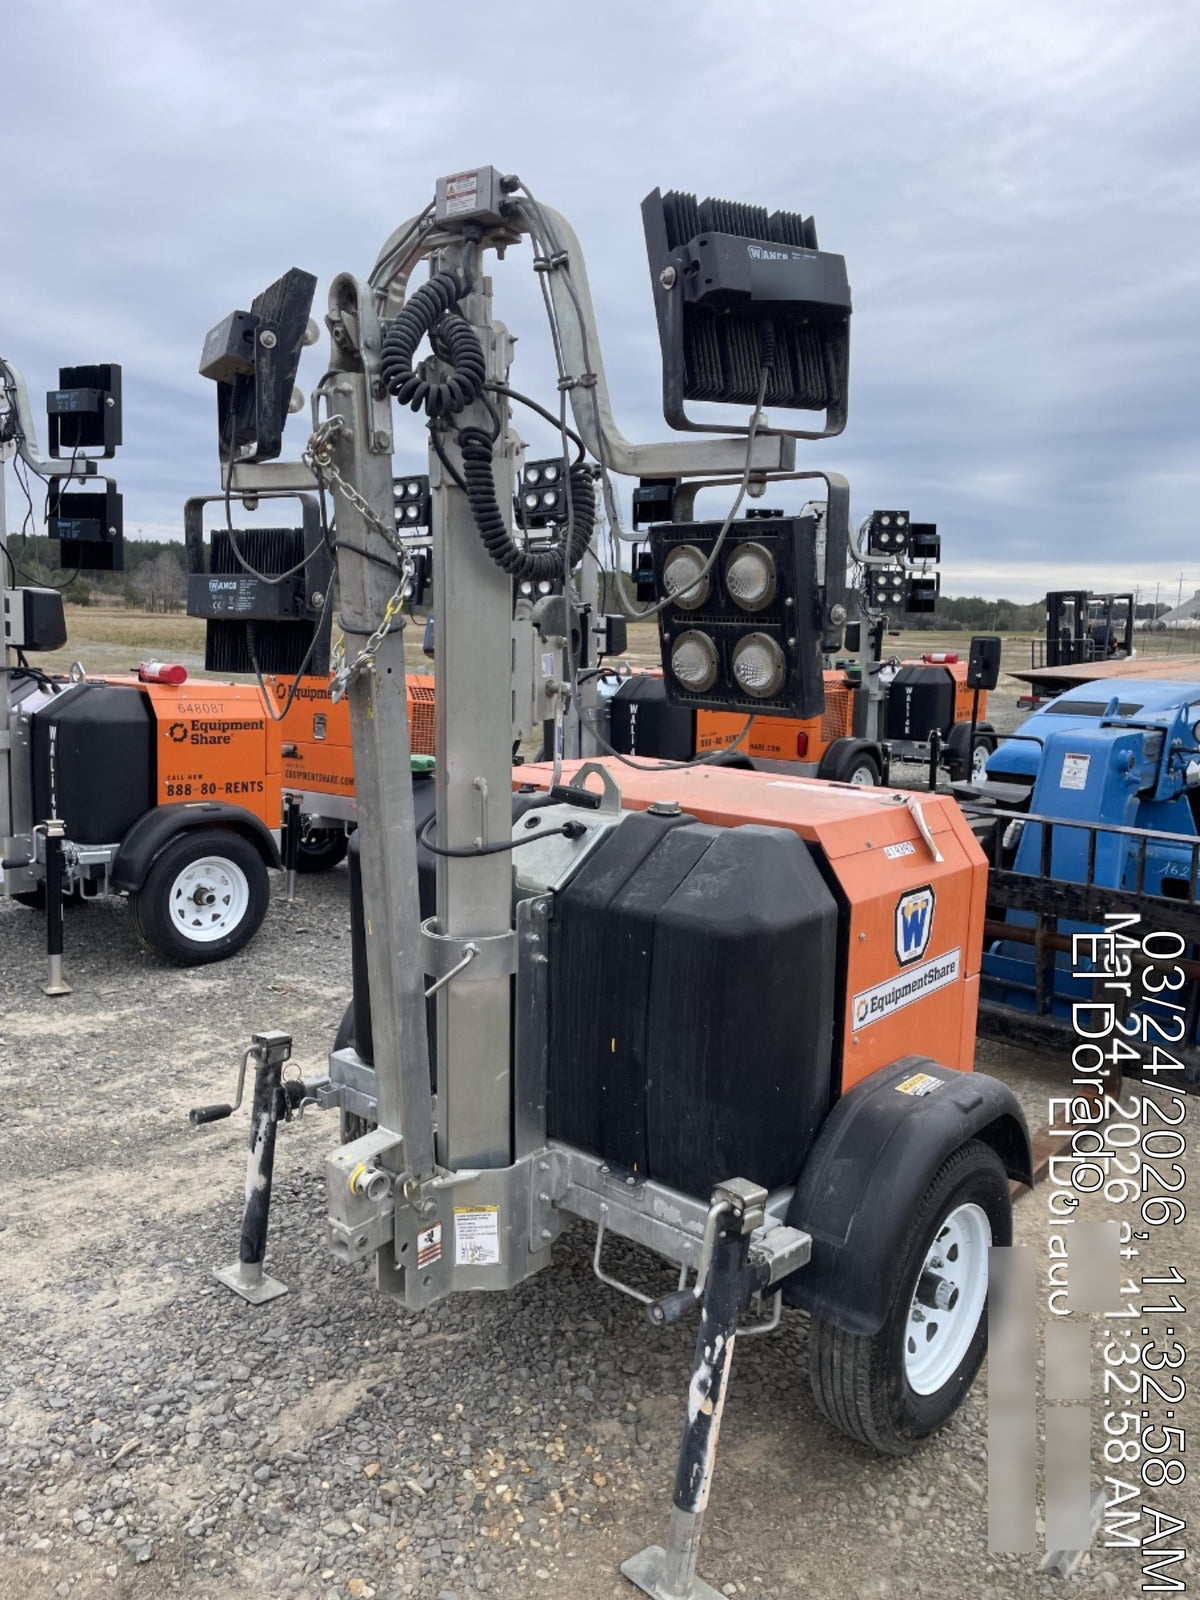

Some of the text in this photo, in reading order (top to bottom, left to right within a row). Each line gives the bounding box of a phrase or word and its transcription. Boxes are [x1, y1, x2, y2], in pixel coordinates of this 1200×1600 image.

[177, 703, 225, 714] 648087
[191, 719, 265, 734] Equipment
[190, 733, 231, 745] Share
[166, 780, 264, 797] 888-80-RENTS
[870, 961, 956, 1014] EquipmentShare
